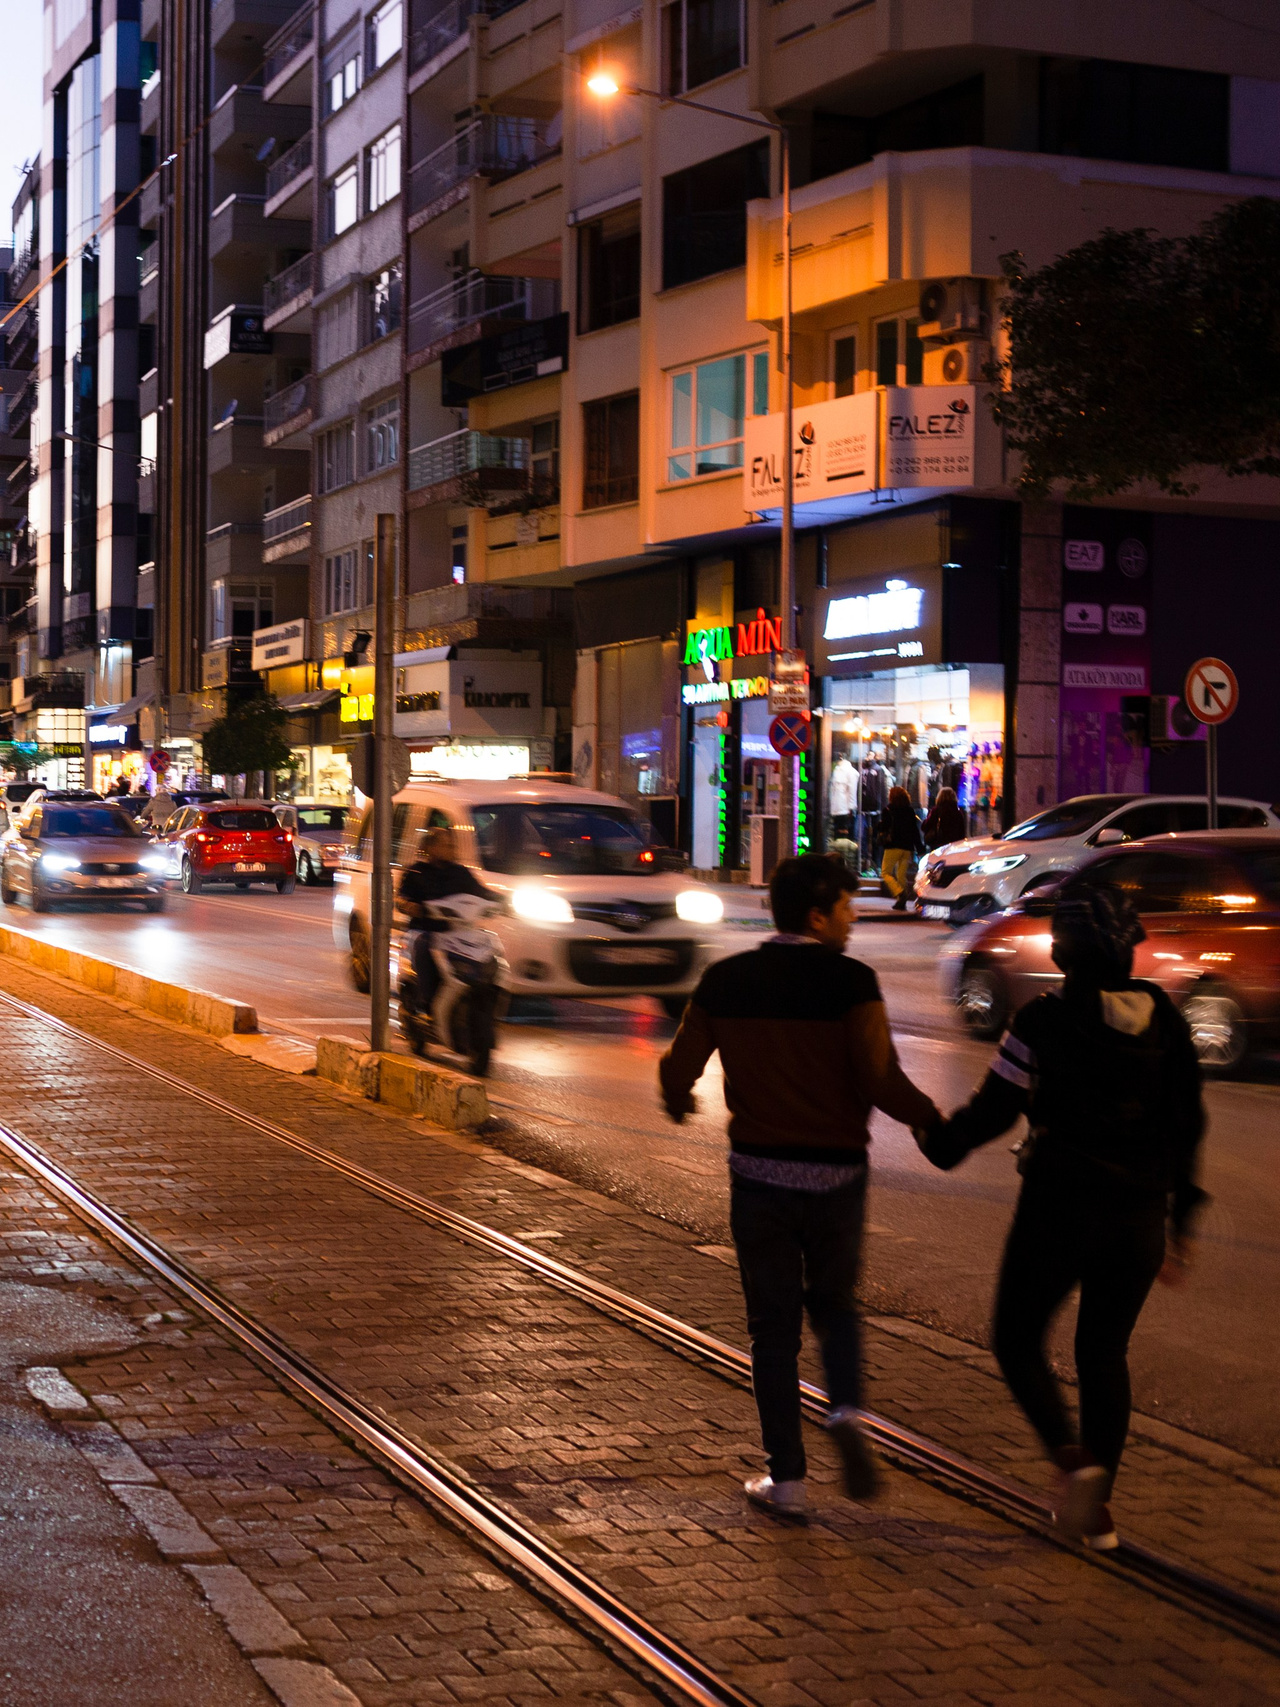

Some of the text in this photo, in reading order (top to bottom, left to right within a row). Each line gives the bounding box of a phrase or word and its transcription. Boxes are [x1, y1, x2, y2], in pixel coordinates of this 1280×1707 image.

[889, 415, 956, 435] FALEZ
[750, 448, 805, 488] FALZ
[1111, 611, 1142, 625] KARL
[683, 627, 733, 664] AQUA
